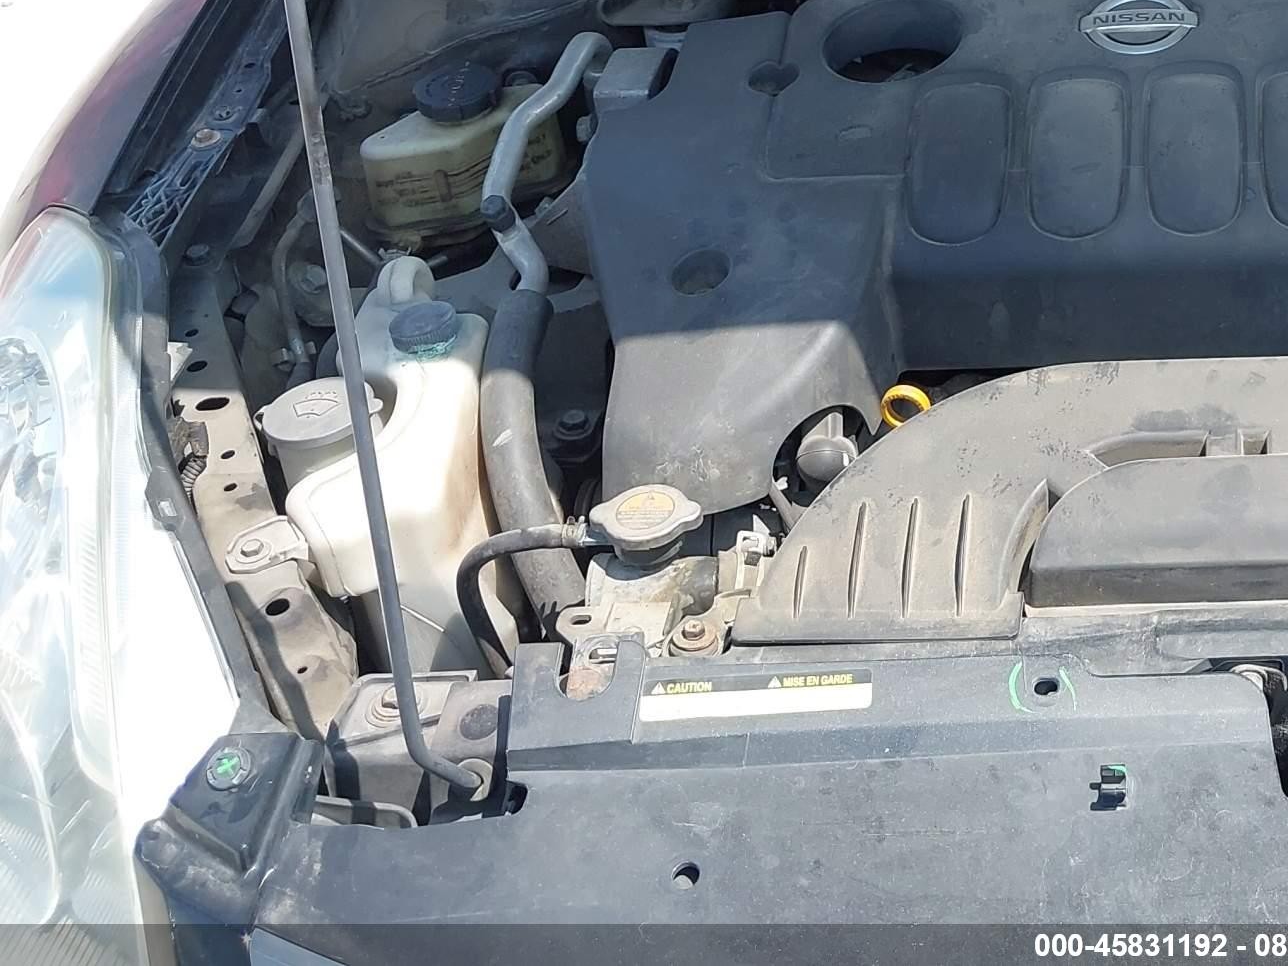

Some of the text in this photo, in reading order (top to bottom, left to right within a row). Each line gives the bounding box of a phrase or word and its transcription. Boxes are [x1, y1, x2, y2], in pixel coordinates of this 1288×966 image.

[1093, 12, 1184, 25] NISSAN
[783, 674, 853, 687] MISE EN GARDE
[666, 681, 712, 694] CAUTION
